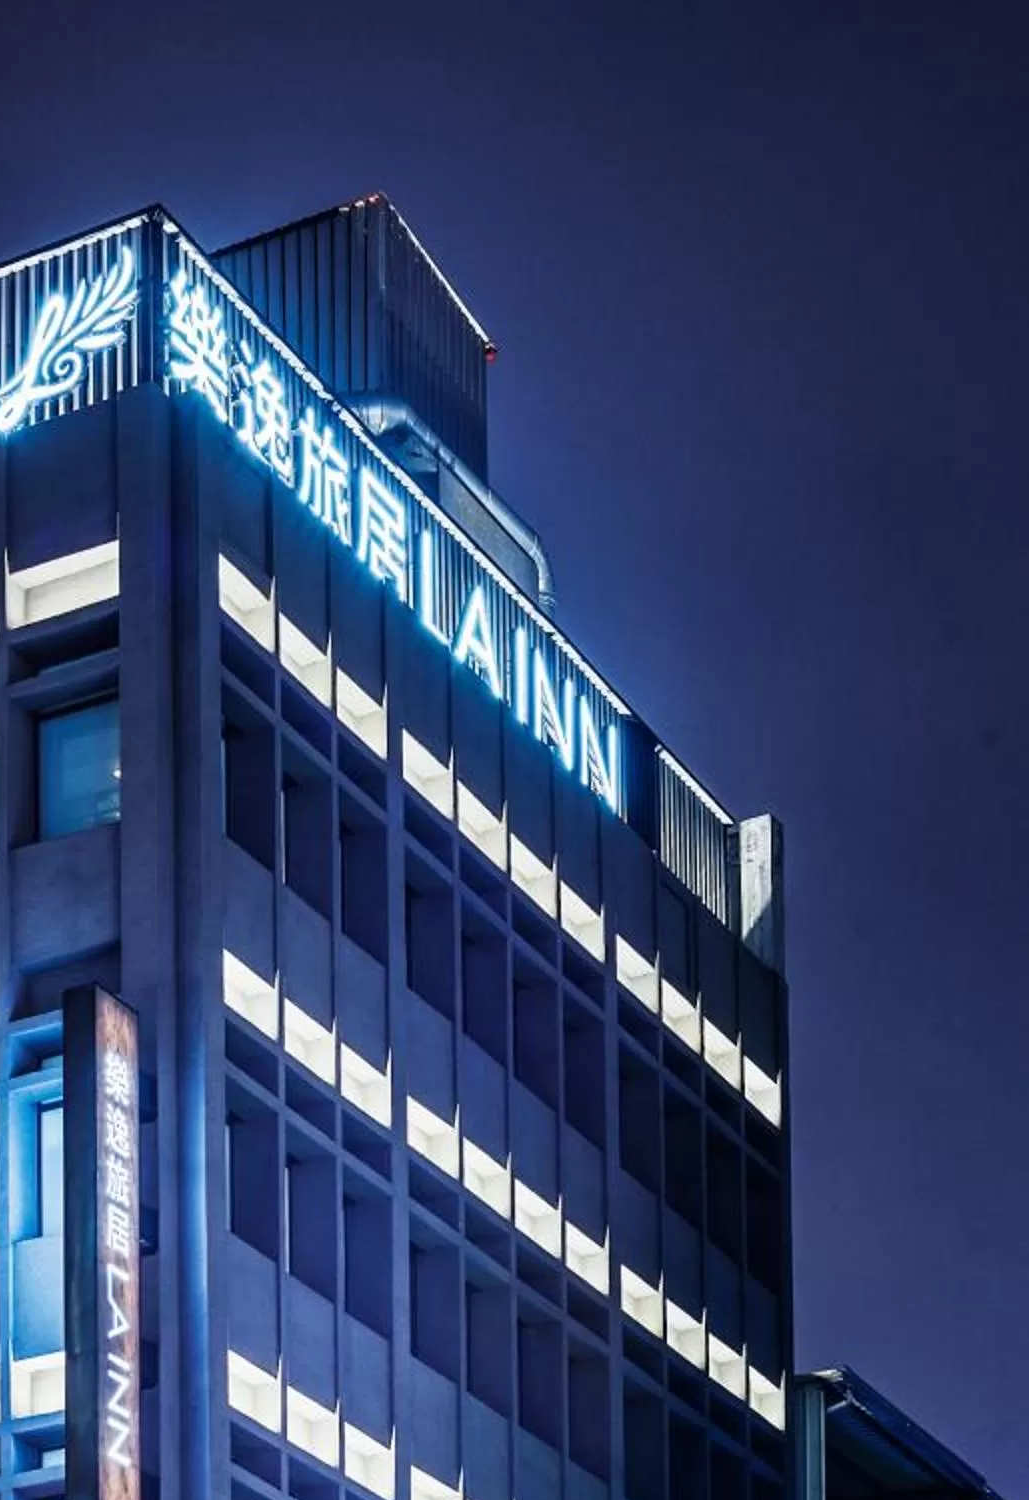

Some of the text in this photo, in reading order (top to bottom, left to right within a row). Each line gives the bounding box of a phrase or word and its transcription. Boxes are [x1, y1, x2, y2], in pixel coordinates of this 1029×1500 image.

[168, 270, 409, 603] 樂逸旅居
[106, 1052, 131, 1261] 樂逸旅居
